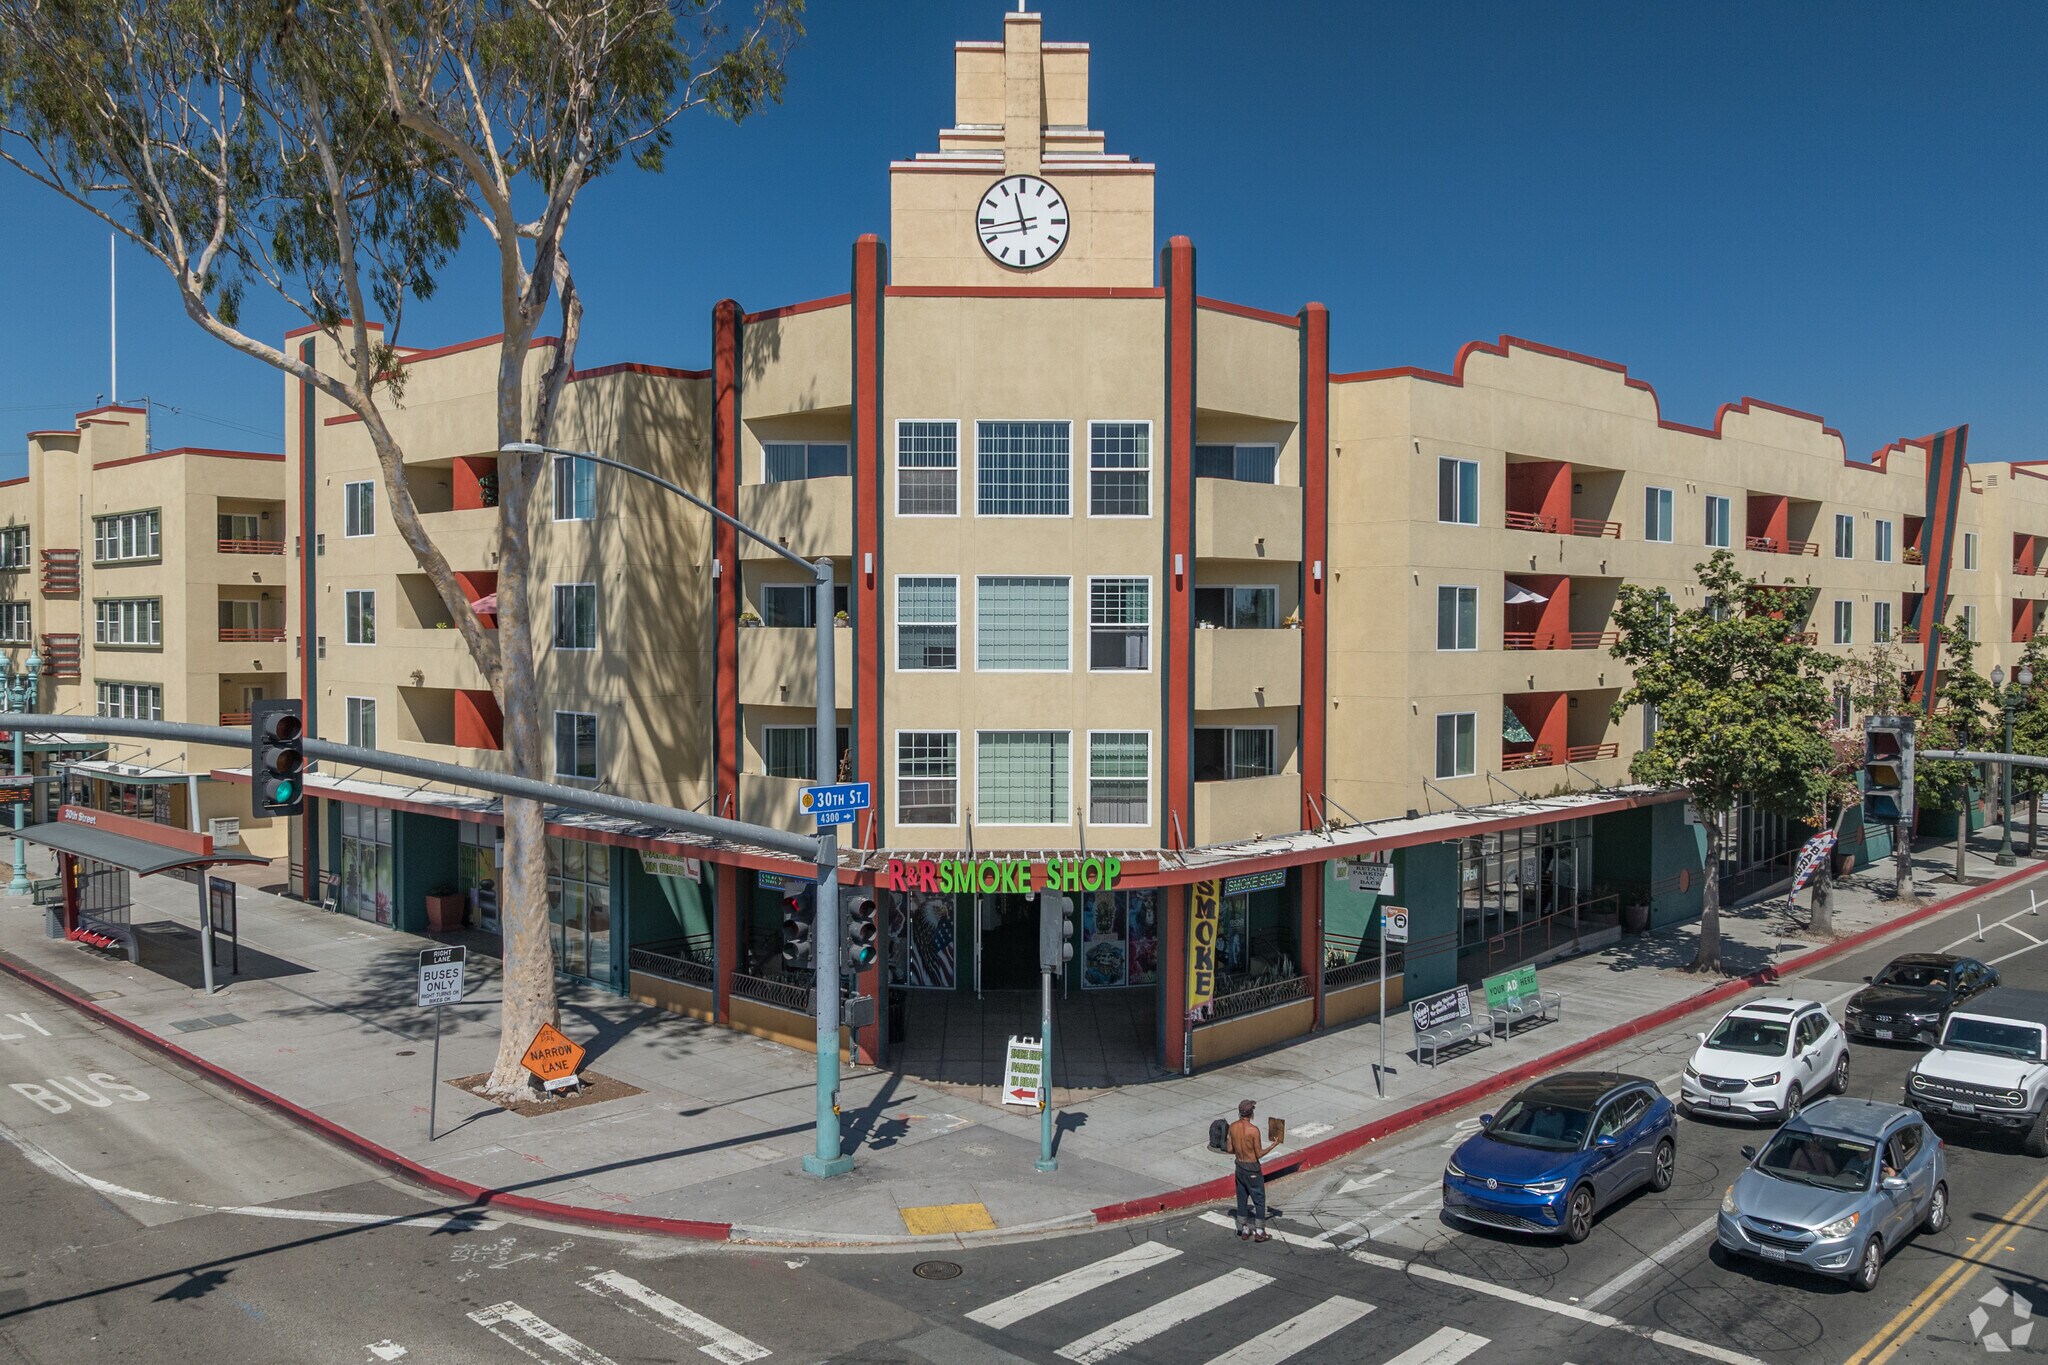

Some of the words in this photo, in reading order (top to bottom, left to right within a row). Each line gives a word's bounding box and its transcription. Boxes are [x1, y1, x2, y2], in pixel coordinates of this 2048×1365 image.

[817, 792, 844, 807] 30TH
[850, 790, 865, 804] ST.
[64, 809, 78, 821] 30th
[78, 812, 97, 825] Street
[821, 812, 839, 823] 4300
[645, 862, 657, 872] IN
[1793, 845, 1820, 885] BARB
[939, 860, 1031, 893] SMOKE
[1046, 857, 1121, 893] SHOP
[1228, 876, 1258, 892] SMOKE
[1260, 871, 1283, 886] SHOP
[1194, 879, 1216, 996] SMOKE
[433, 949, 452, 957] RIGHT
[424, 968, 459, 981] BUSES
[427, 980, 454, 991] ONLY
[1489, 984, 1506, 996] YOUR
[1507, 979, 1518, 992] AD
[530, 1044, 572, 1061] NARROW
[541, 1060, 569, 1074] LANE
[1010, 1062, 1041, 1075] PARKING
[8, 1072, 150, 1114] BUS
[1936, 1084, 1995, 1098] BRONCO
